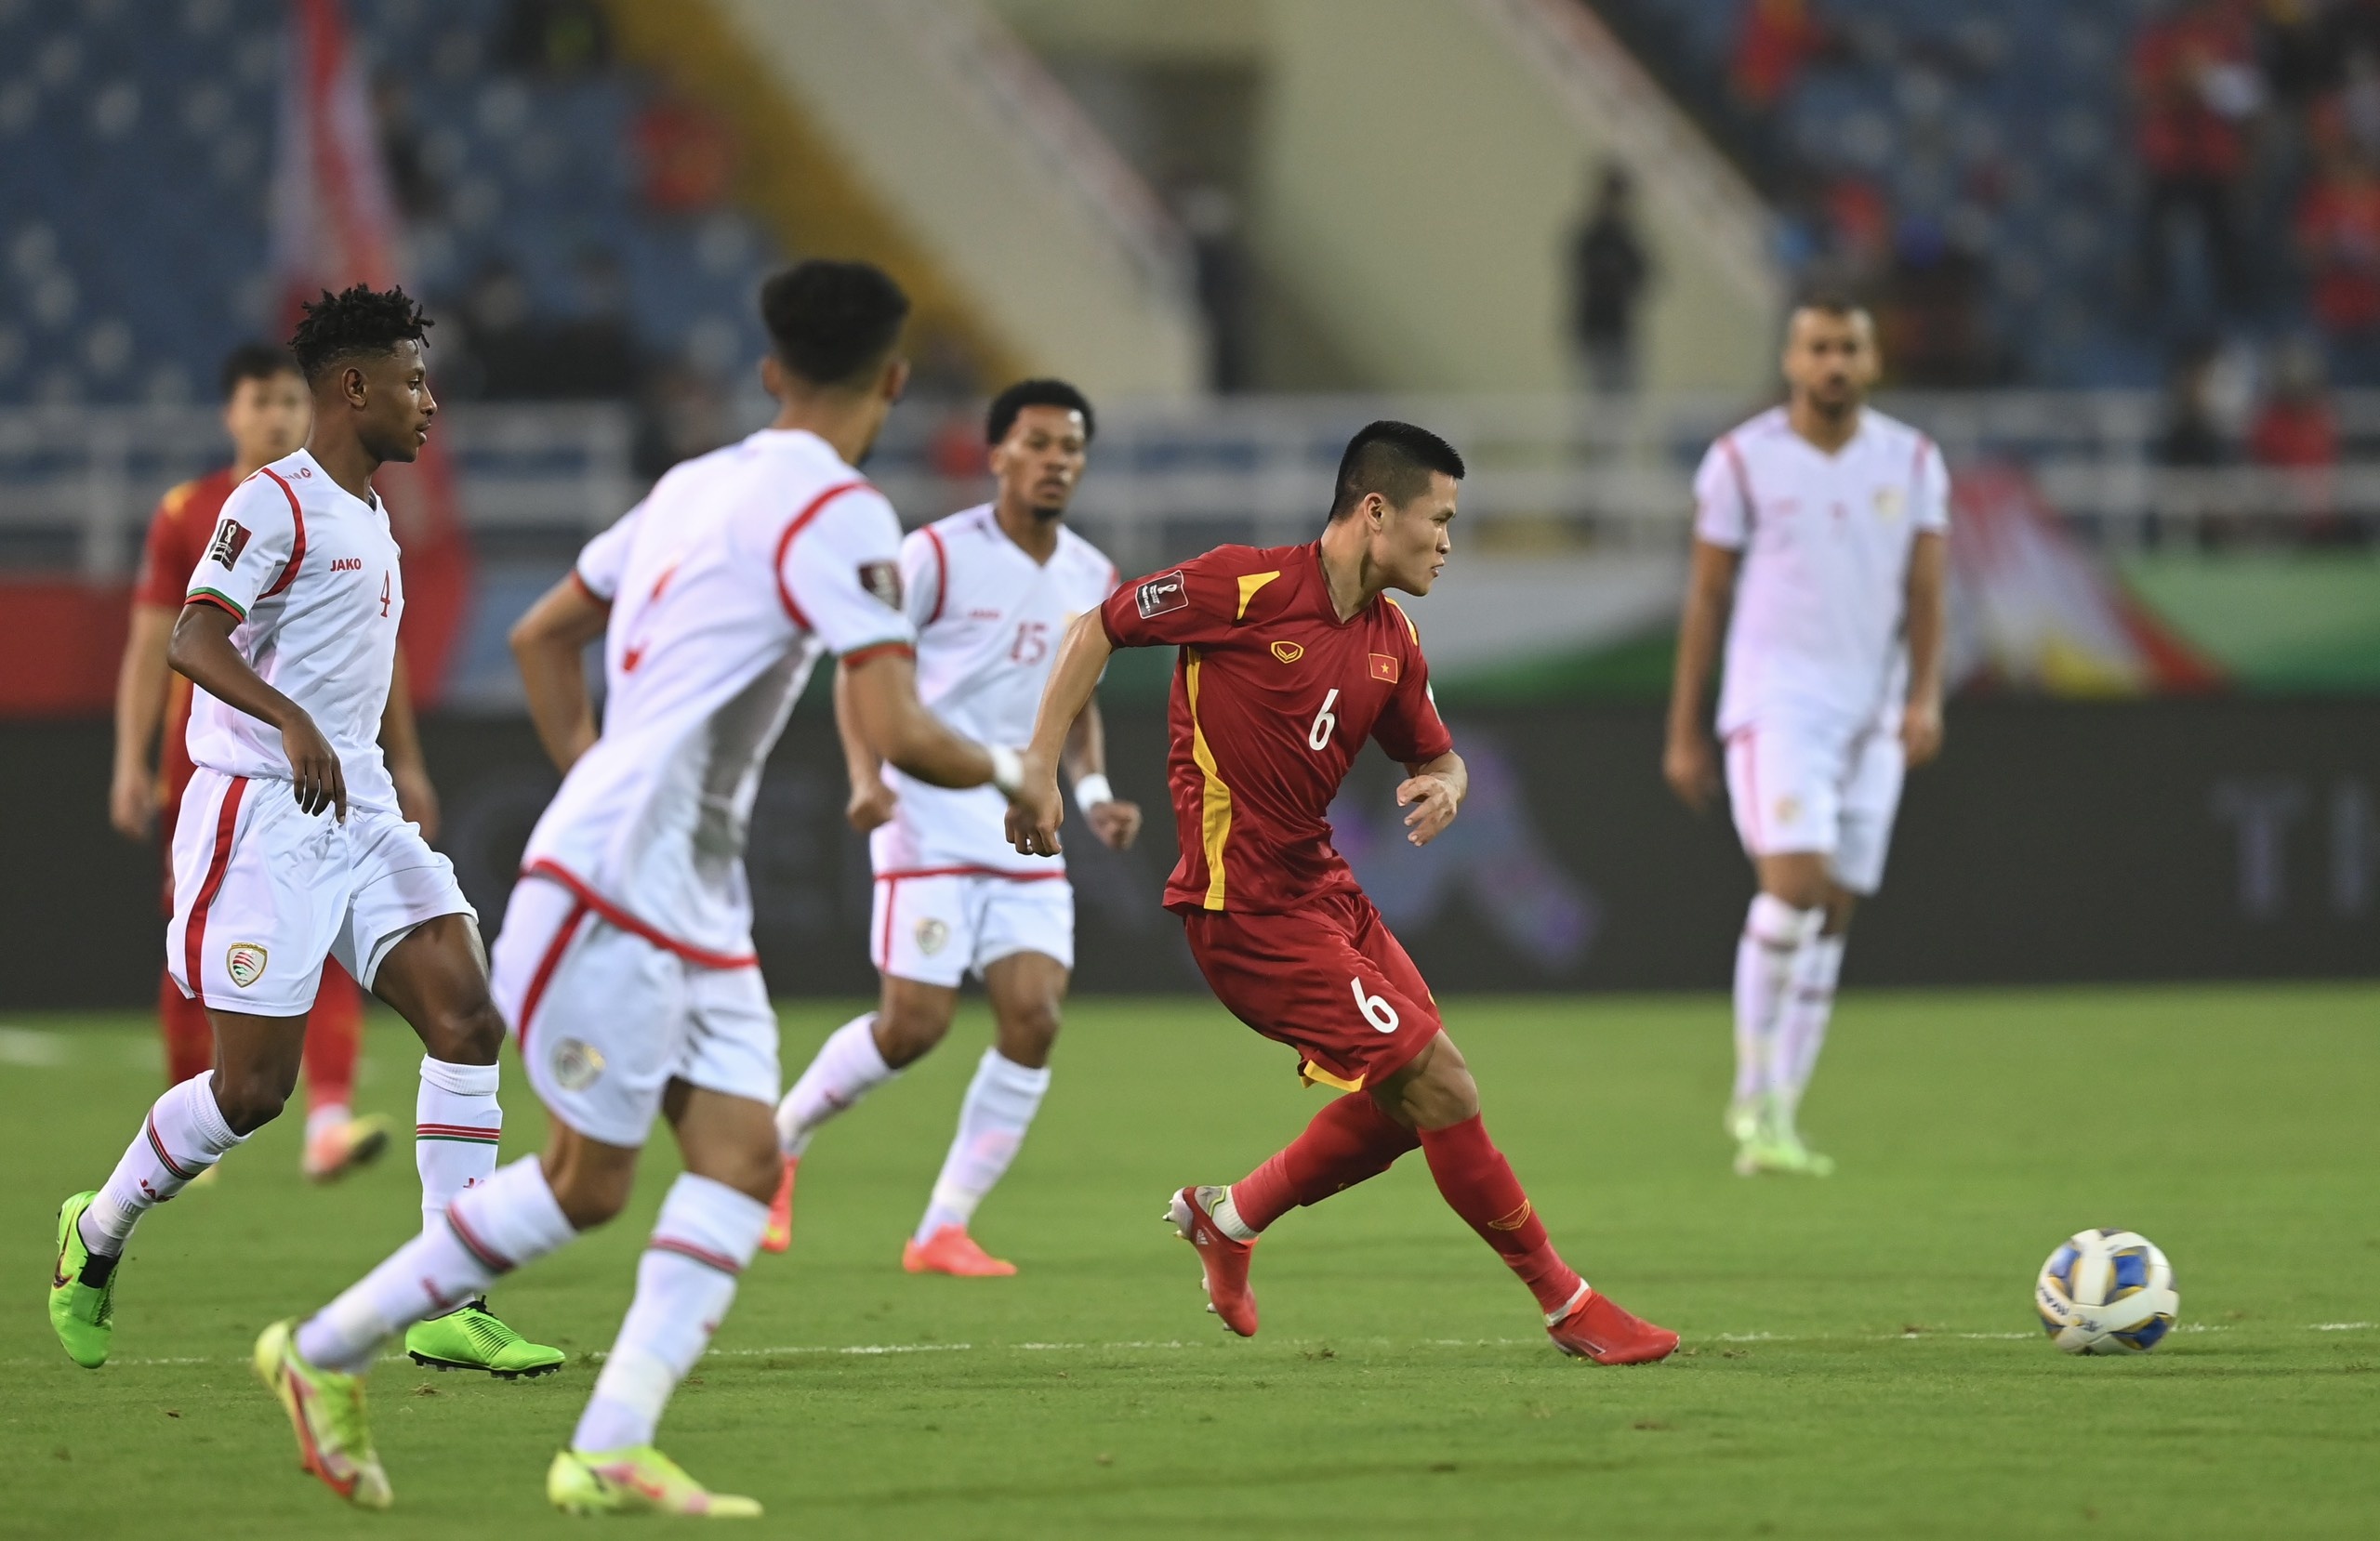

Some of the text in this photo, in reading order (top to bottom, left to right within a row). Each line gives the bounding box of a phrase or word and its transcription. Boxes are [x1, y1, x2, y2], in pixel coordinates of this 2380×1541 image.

[330, 558, 362, 572] JAKO
[379, 569, 390, 618] 4
[1011, 622, 1048, 665] 15
[1308, 688, 1339, 751] 6
[1350, 976, 1399, 1034] 6
